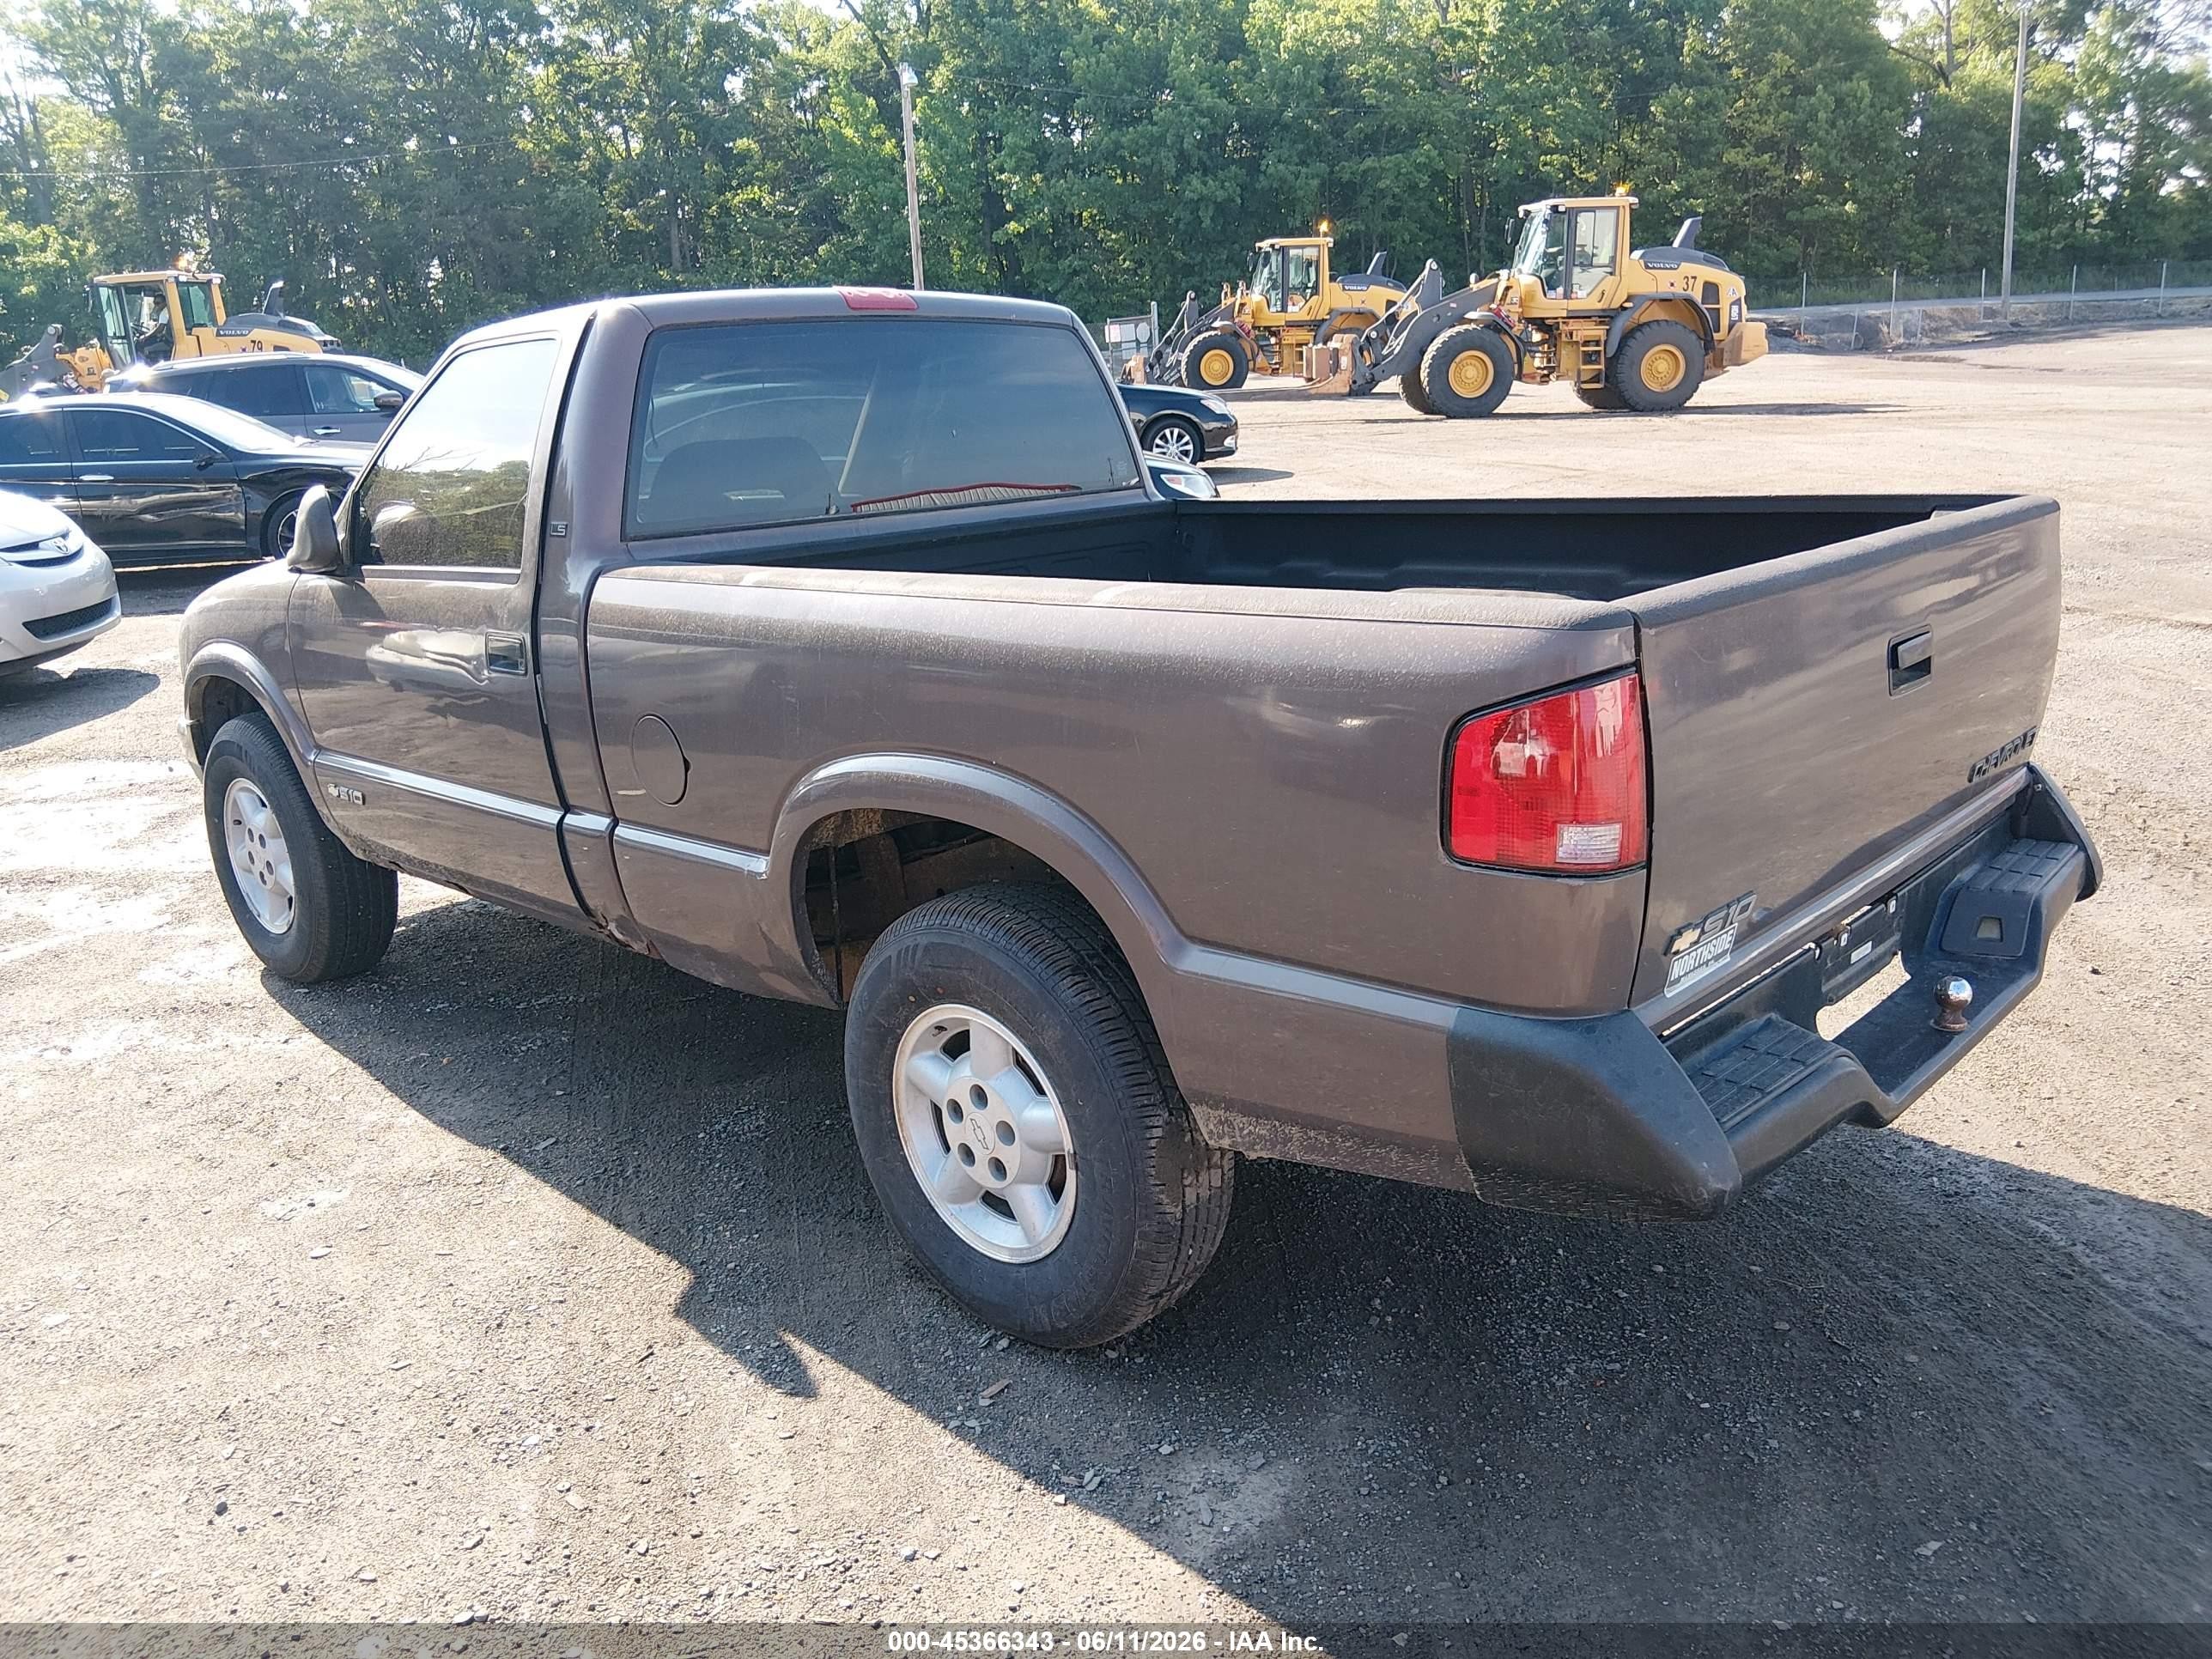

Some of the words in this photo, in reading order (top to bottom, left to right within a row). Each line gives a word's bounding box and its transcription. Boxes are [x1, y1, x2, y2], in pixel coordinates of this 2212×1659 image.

[1682, 276, 1698, 292] 37
[251, 340, 263, 352] 79
[550, 524, 566, 536] LS
[1670, 929, 1734, 981] NORTHSIDE
